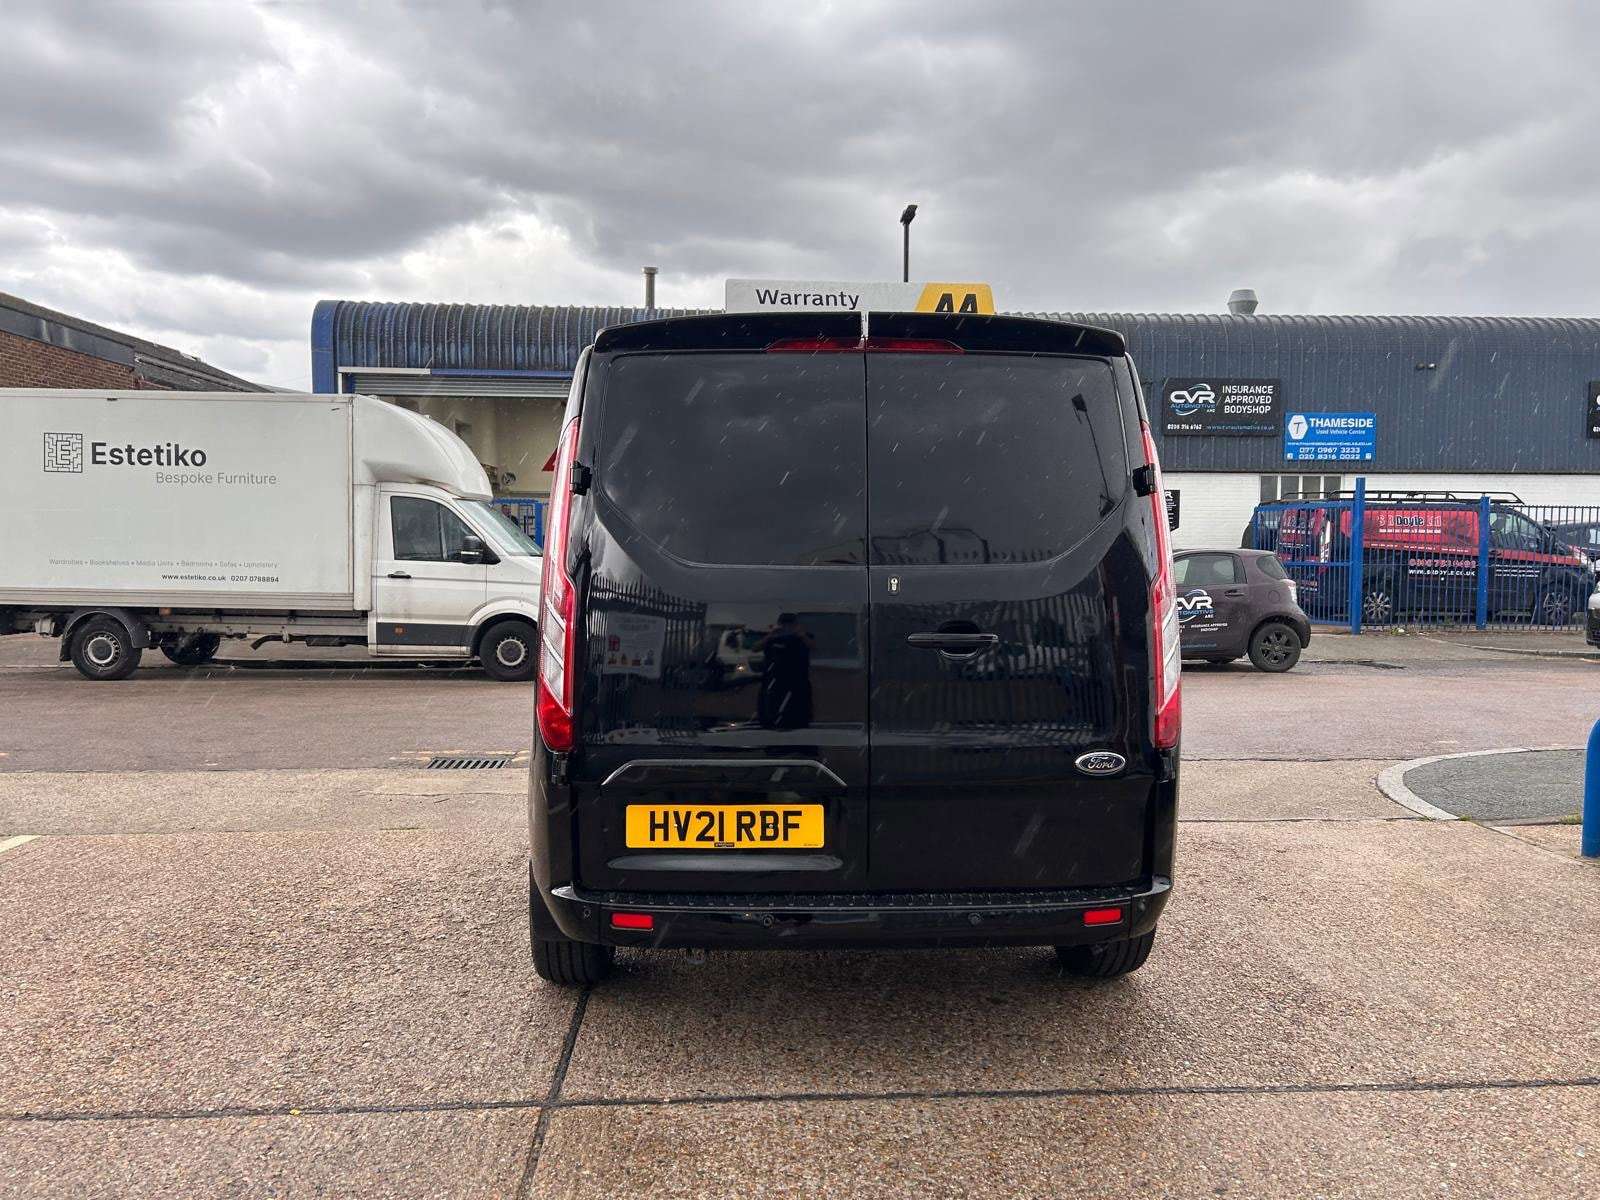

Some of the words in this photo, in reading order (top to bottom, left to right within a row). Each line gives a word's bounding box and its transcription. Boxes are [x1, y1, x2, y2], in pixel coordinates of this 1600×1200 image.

[755, 288, 860, 310] Warranty
[935, 293, 979, 313] AA
[1222, 385, 1274, 394] INSURANCE
[1170, 390, 1216, 403] CVR
[1224, 395, 1272, 404] APPROVED
[1224, 405, 1271, 414] BODYSHOP
[1309, 418, 1374, 428] THAMESIDE
[91, 441, 207, 467] Estetiko
[155, 471, 213, 486] Bespoke
[217, 472, 277, 485] Furniture
[1396, 514, 1425, 527] Doyle
[1087, 756, 1116, 769] Ford
[650, 810, 725, 842] HV21
[736, 810, 803, 842] RBF
